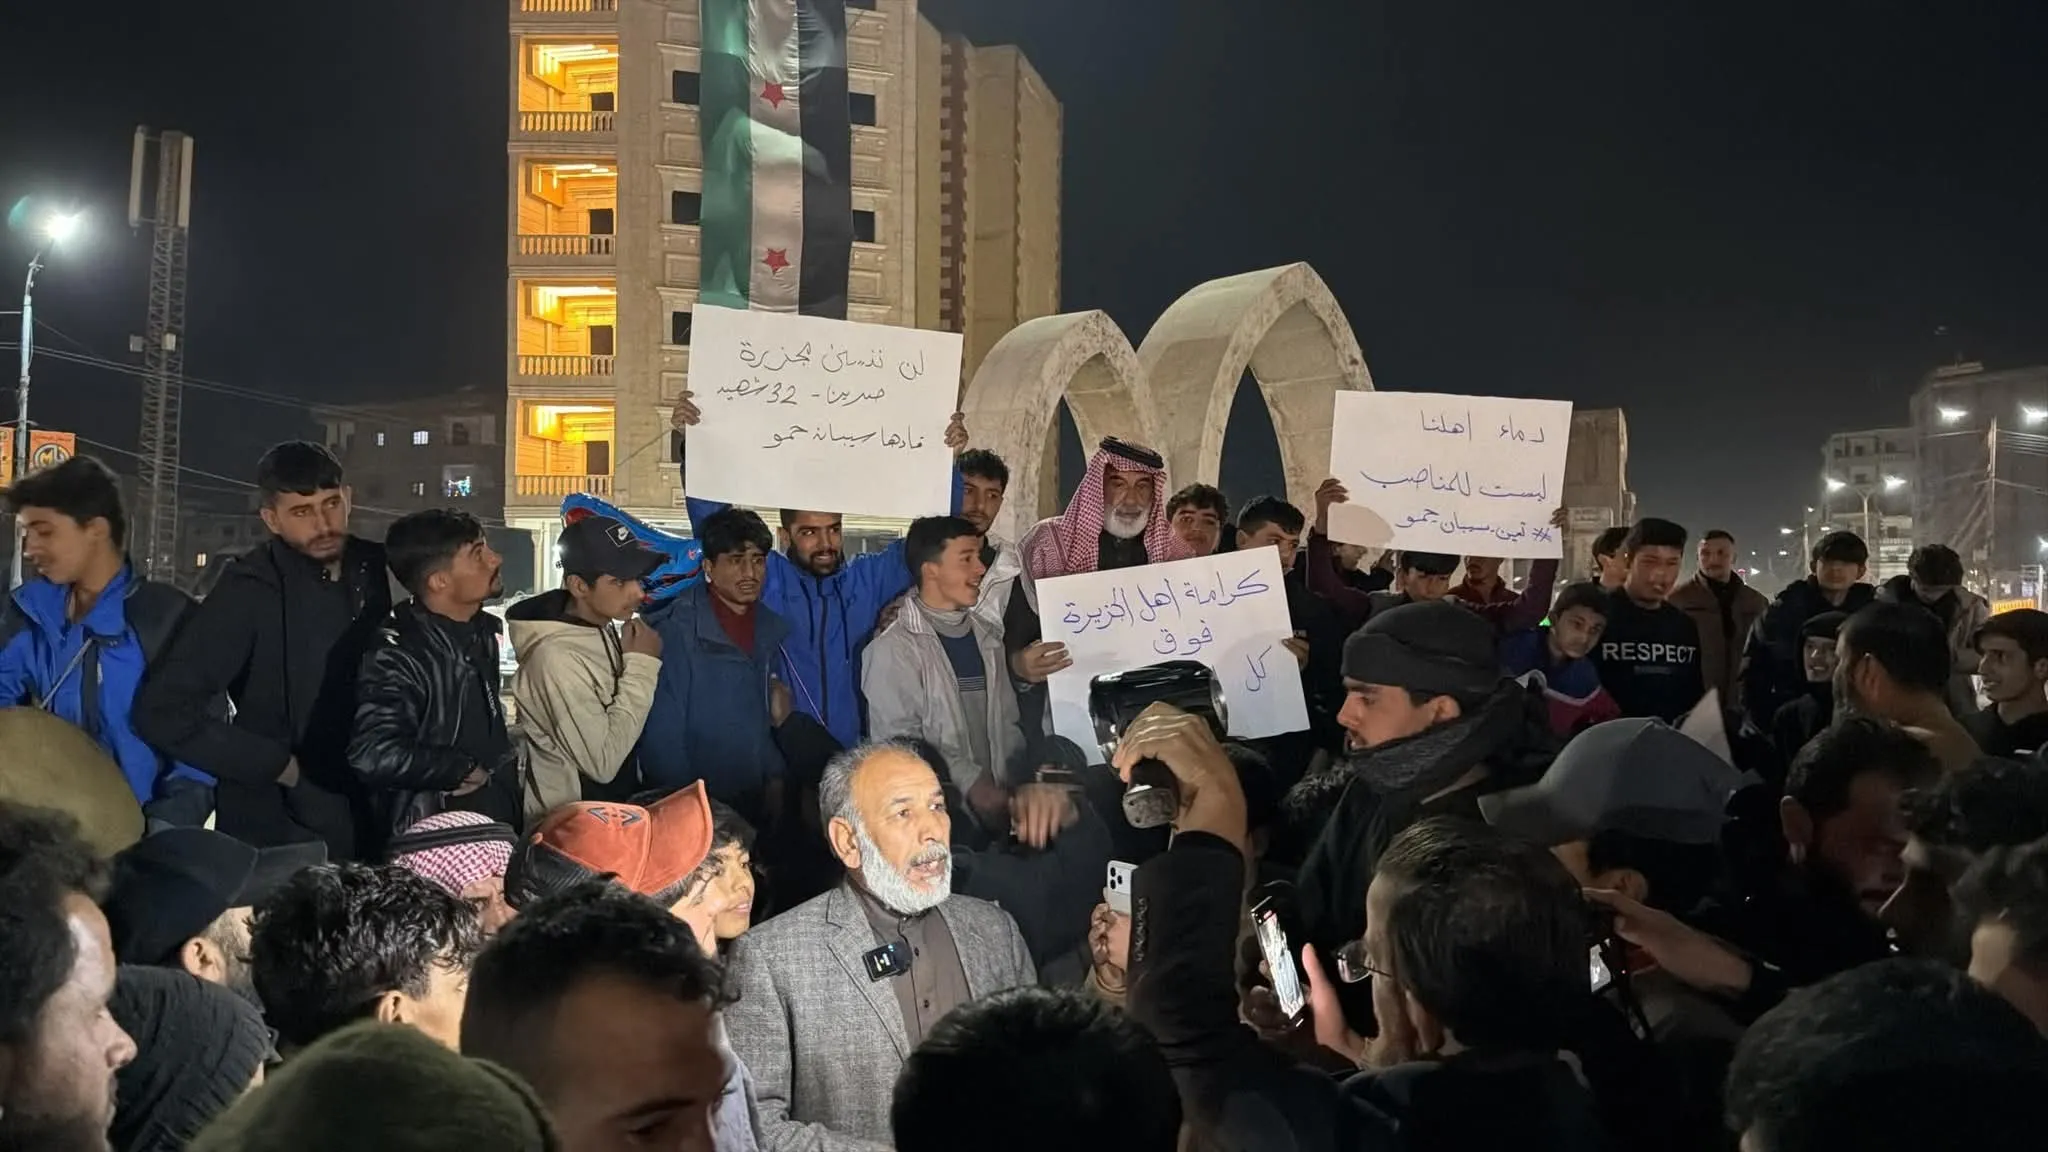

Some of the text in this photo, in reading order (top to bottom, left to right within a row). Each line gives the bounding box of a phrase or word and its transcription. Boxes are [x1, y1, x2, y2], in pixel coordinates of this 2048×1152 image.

[899, 349, 924, 380] لن
[767, 382, 798, 405] 32
[1498, 414, 1545, 443] دماء
[1360, 463, 1547, 502] ليست للمناصب
[1184, 569, 1270, 607] كرامة
[1063, 586, 1135, 634] الجزيرة
[1152, 619, 1213, 655] فوق
[1602, 642, 1697, 663] RESPECT
[1244, 645, 1273, 692] كل
